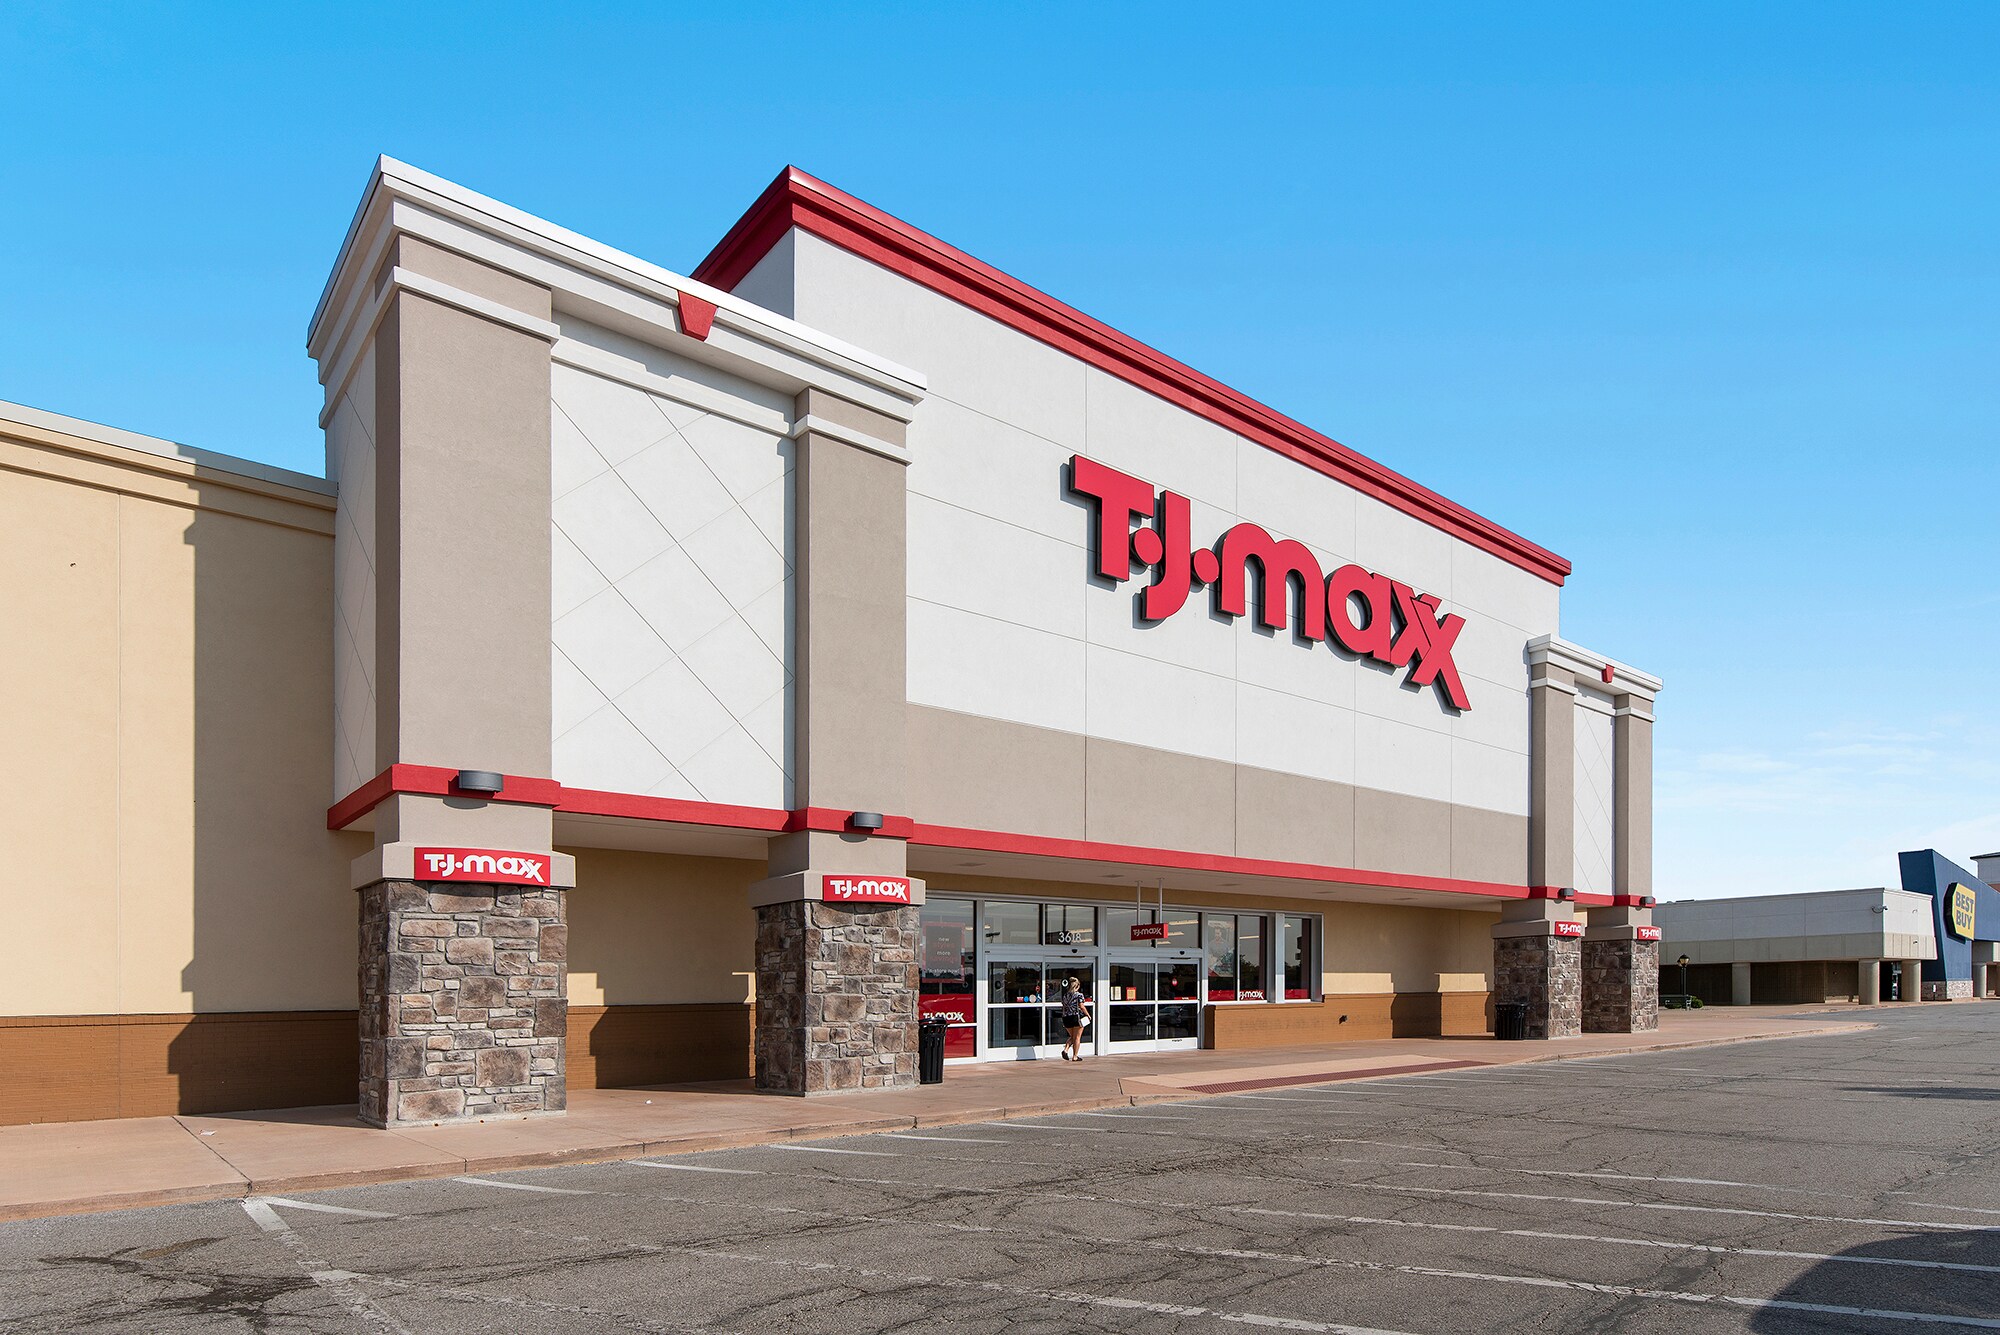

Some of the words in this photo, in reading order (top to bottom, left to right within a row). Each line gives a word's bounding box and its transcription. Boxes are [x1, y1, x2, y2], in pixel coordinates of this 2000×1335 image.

[1955, 891, 1974, 914] BEST
[1956, 909, 1973, 930] BUY
[1058, 931, 1082, 943] 3618
